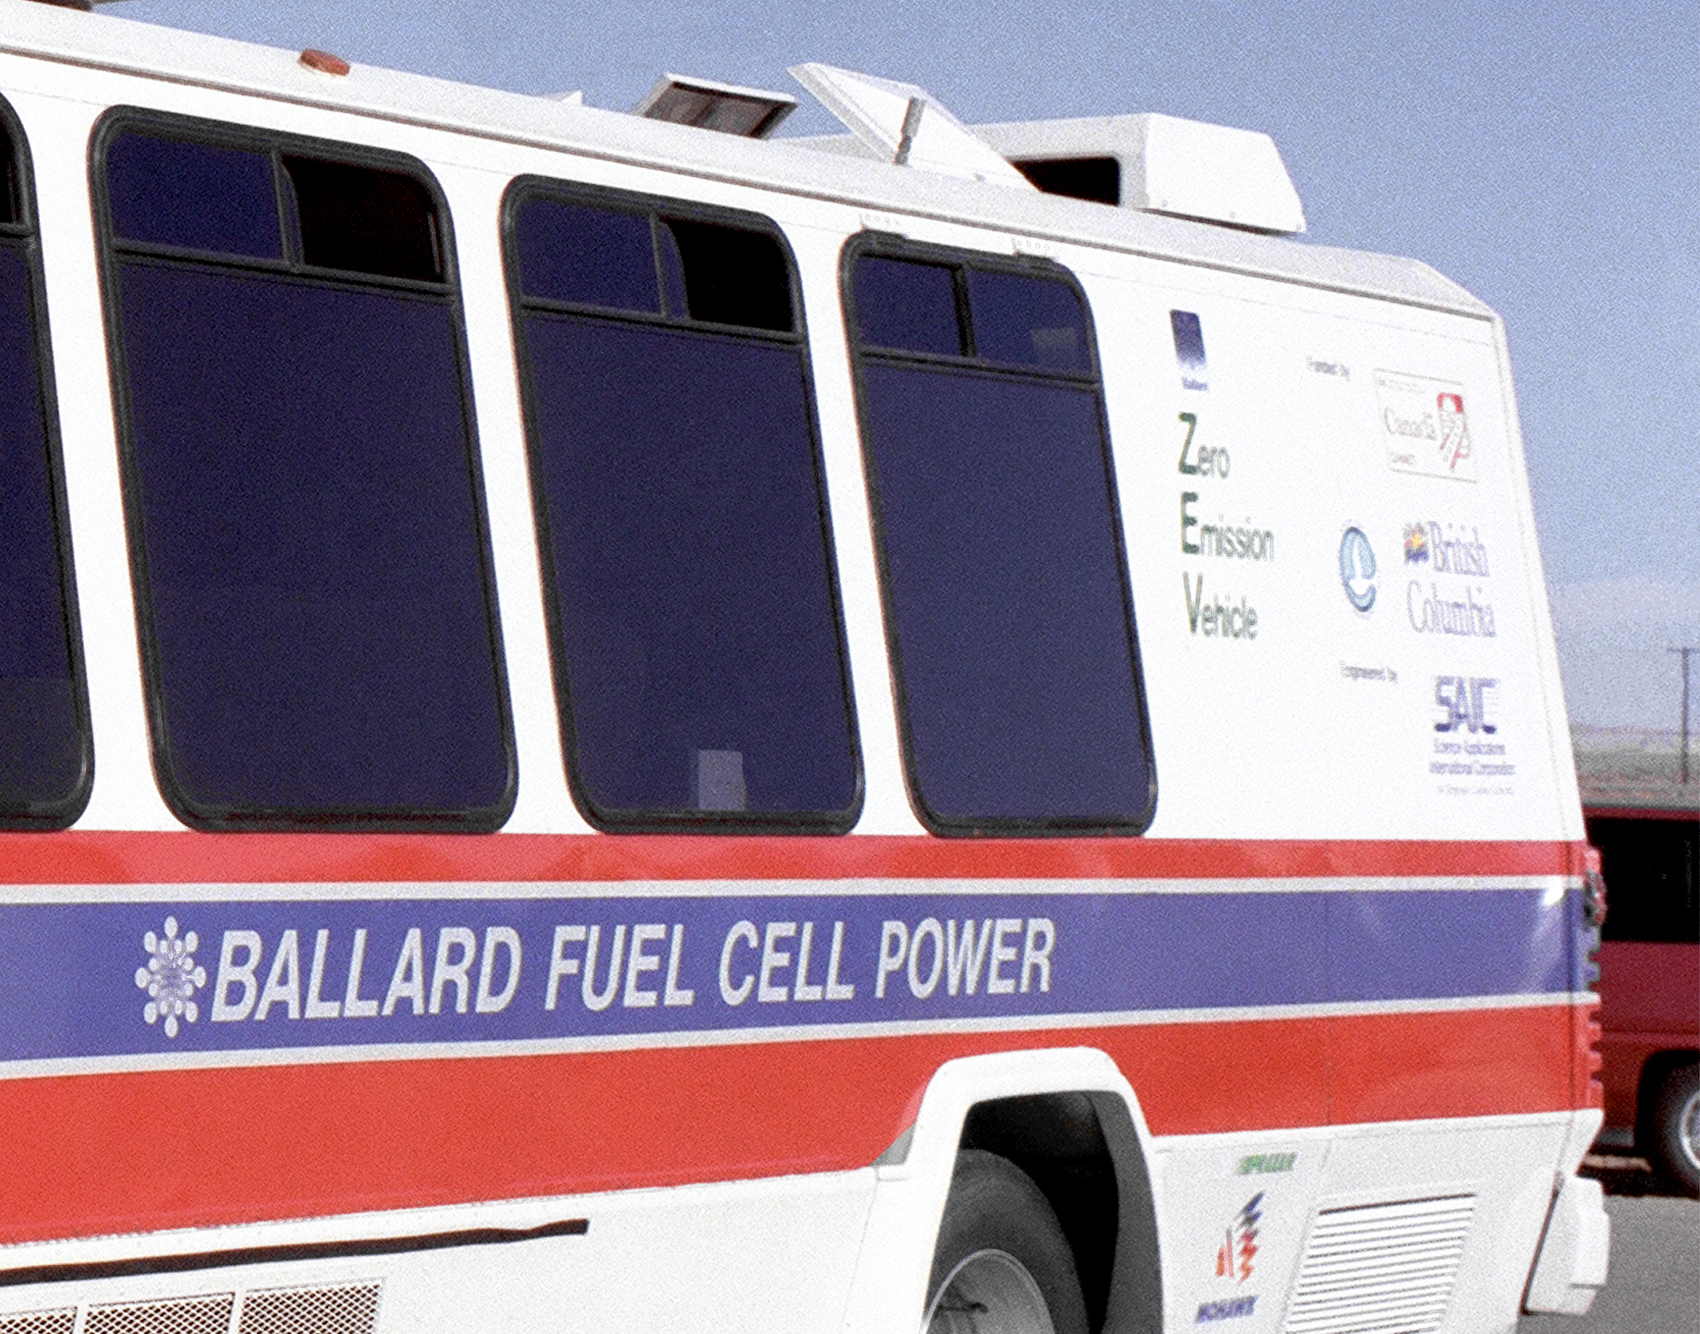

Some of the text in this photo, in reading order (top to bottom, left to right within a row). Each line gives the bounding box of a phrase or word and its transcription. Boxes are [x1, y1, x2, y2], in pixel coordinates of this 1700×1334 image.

[1178, 411, 1231, 479] Zero
[1180, 491, 1275, 563] Emission
[1427, 520, 1491, 578] British
[1183, 570, 1258, 640] Vehicle
[1406, 580, 1498, 638] Columbia
[1433, 674, 1501, 735] SAIC
[211, 917, 1056, 1023] BALLARD FUEL CELL POWER
